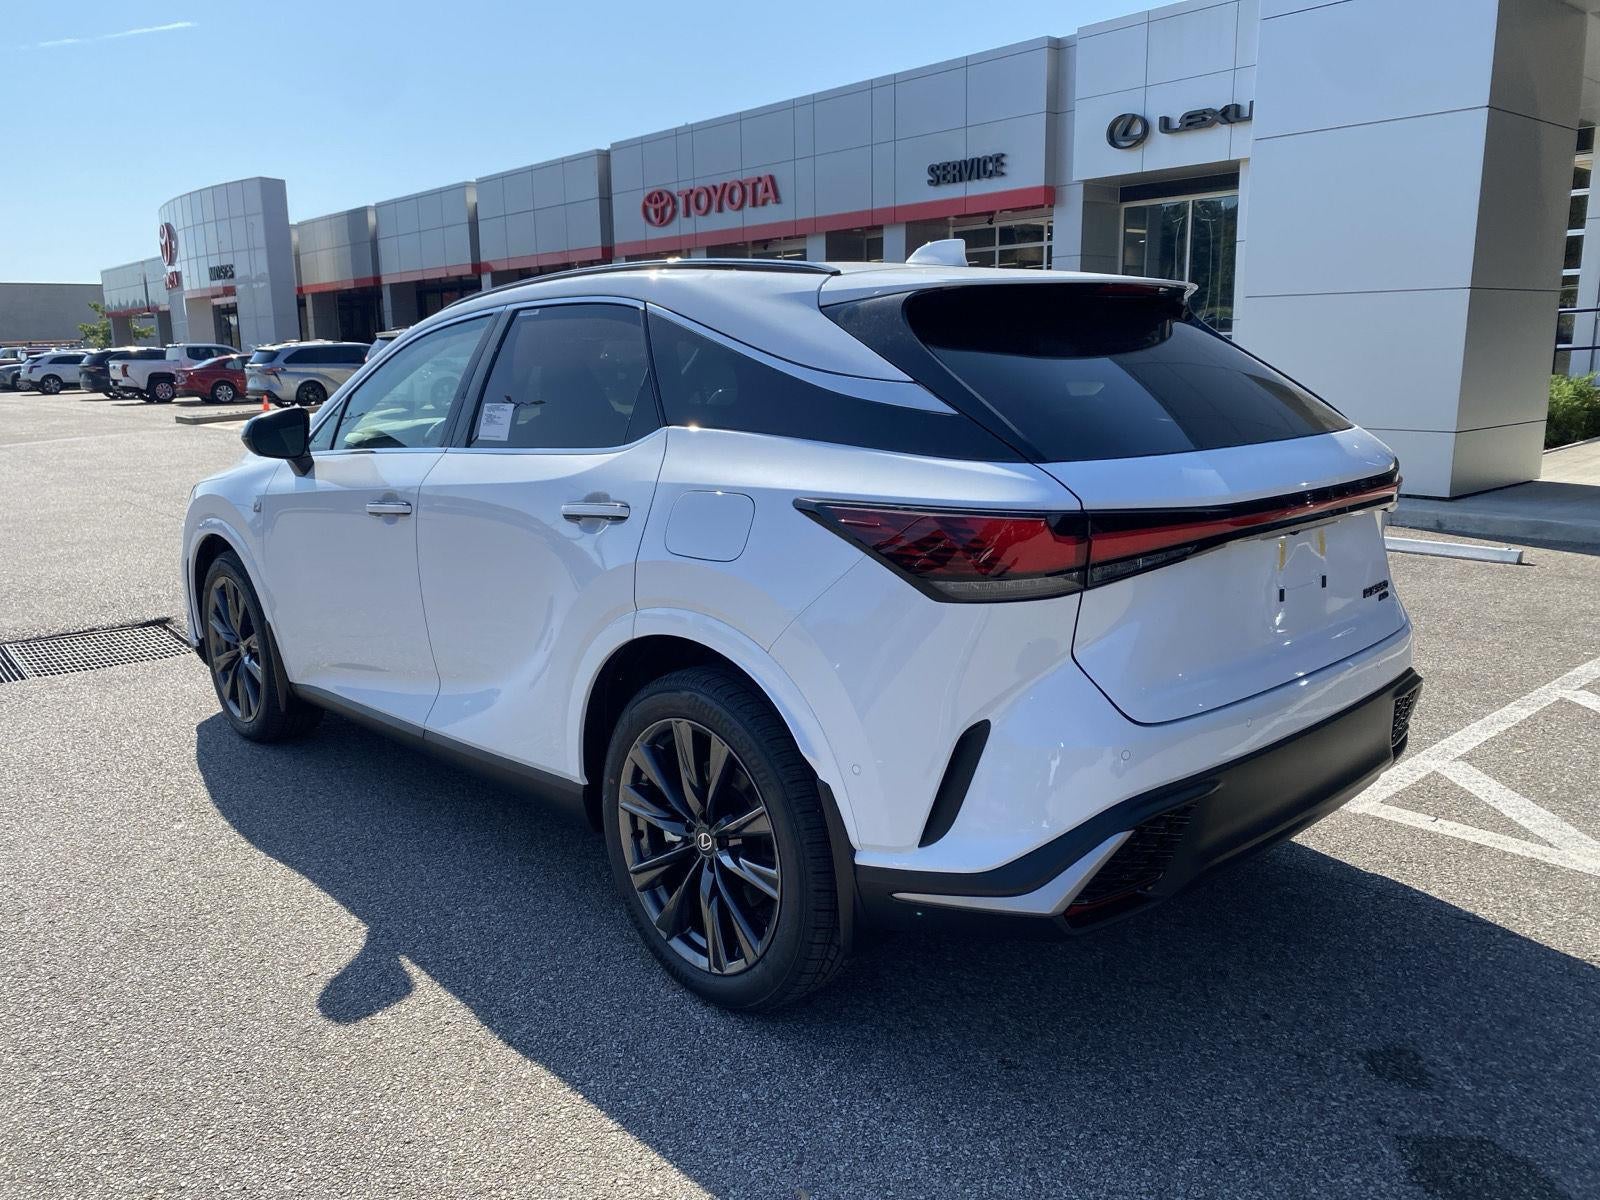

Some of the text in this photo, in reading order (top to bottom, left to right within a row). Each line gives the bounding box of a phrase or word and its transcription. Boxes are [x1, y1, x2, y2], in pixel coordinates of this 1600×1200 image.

[1158, 100, 1254, 134] LEXU
[927, 153, 1007, 187] SERVICE
[677, 174, 781, 218] TOYOTA
